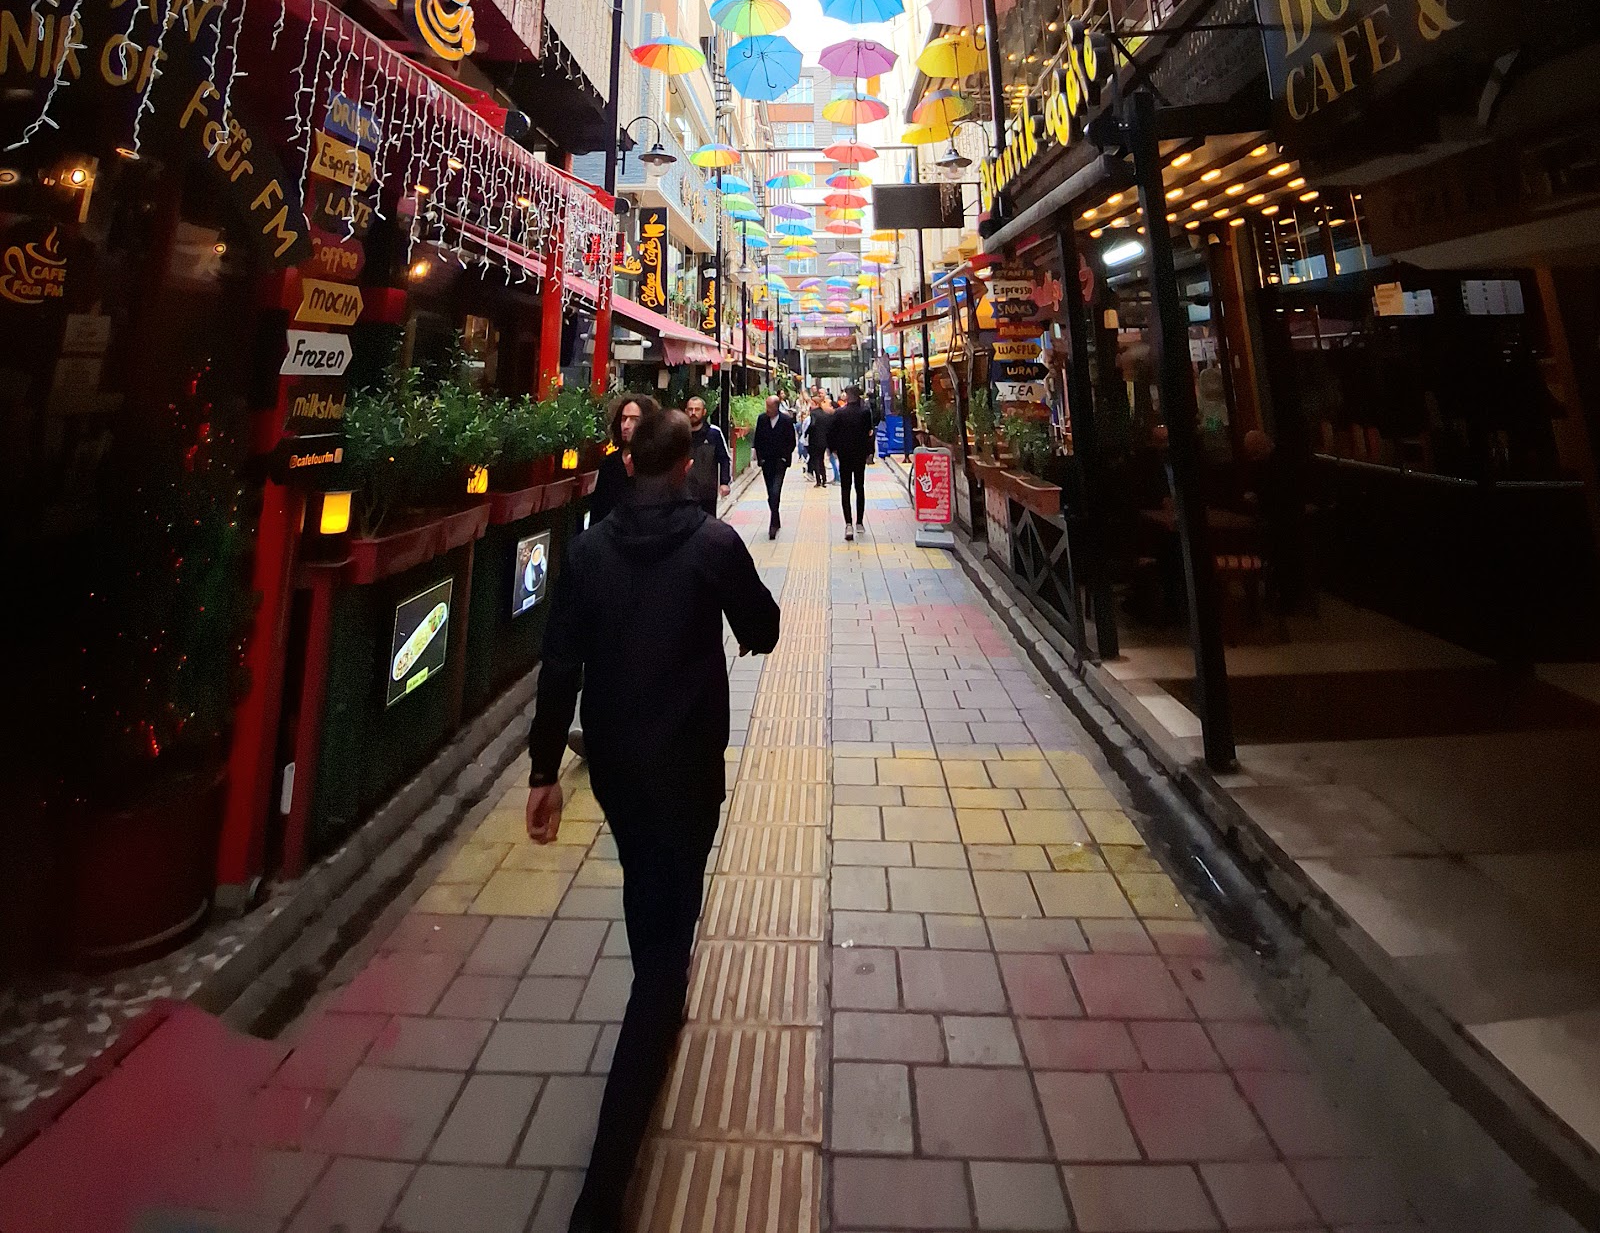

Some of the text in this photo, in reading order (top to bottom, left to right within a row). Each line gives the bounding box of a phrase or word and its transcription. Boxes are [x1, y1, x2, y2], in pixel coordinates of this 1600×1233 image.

[1286, 3, 1401, 120] CAFE
[250, 179, 299, 258] FM
[993, 284, 1033, 296] Espresso
[309, 287, 359, 318] MOCHA
[292, 338, 345, 370] Frozen
[998, 343, 1037, 356] WAFFLE
[1006, 365, 1040, 378] WRAP
[1008, 385, 1034, 397] TEA
